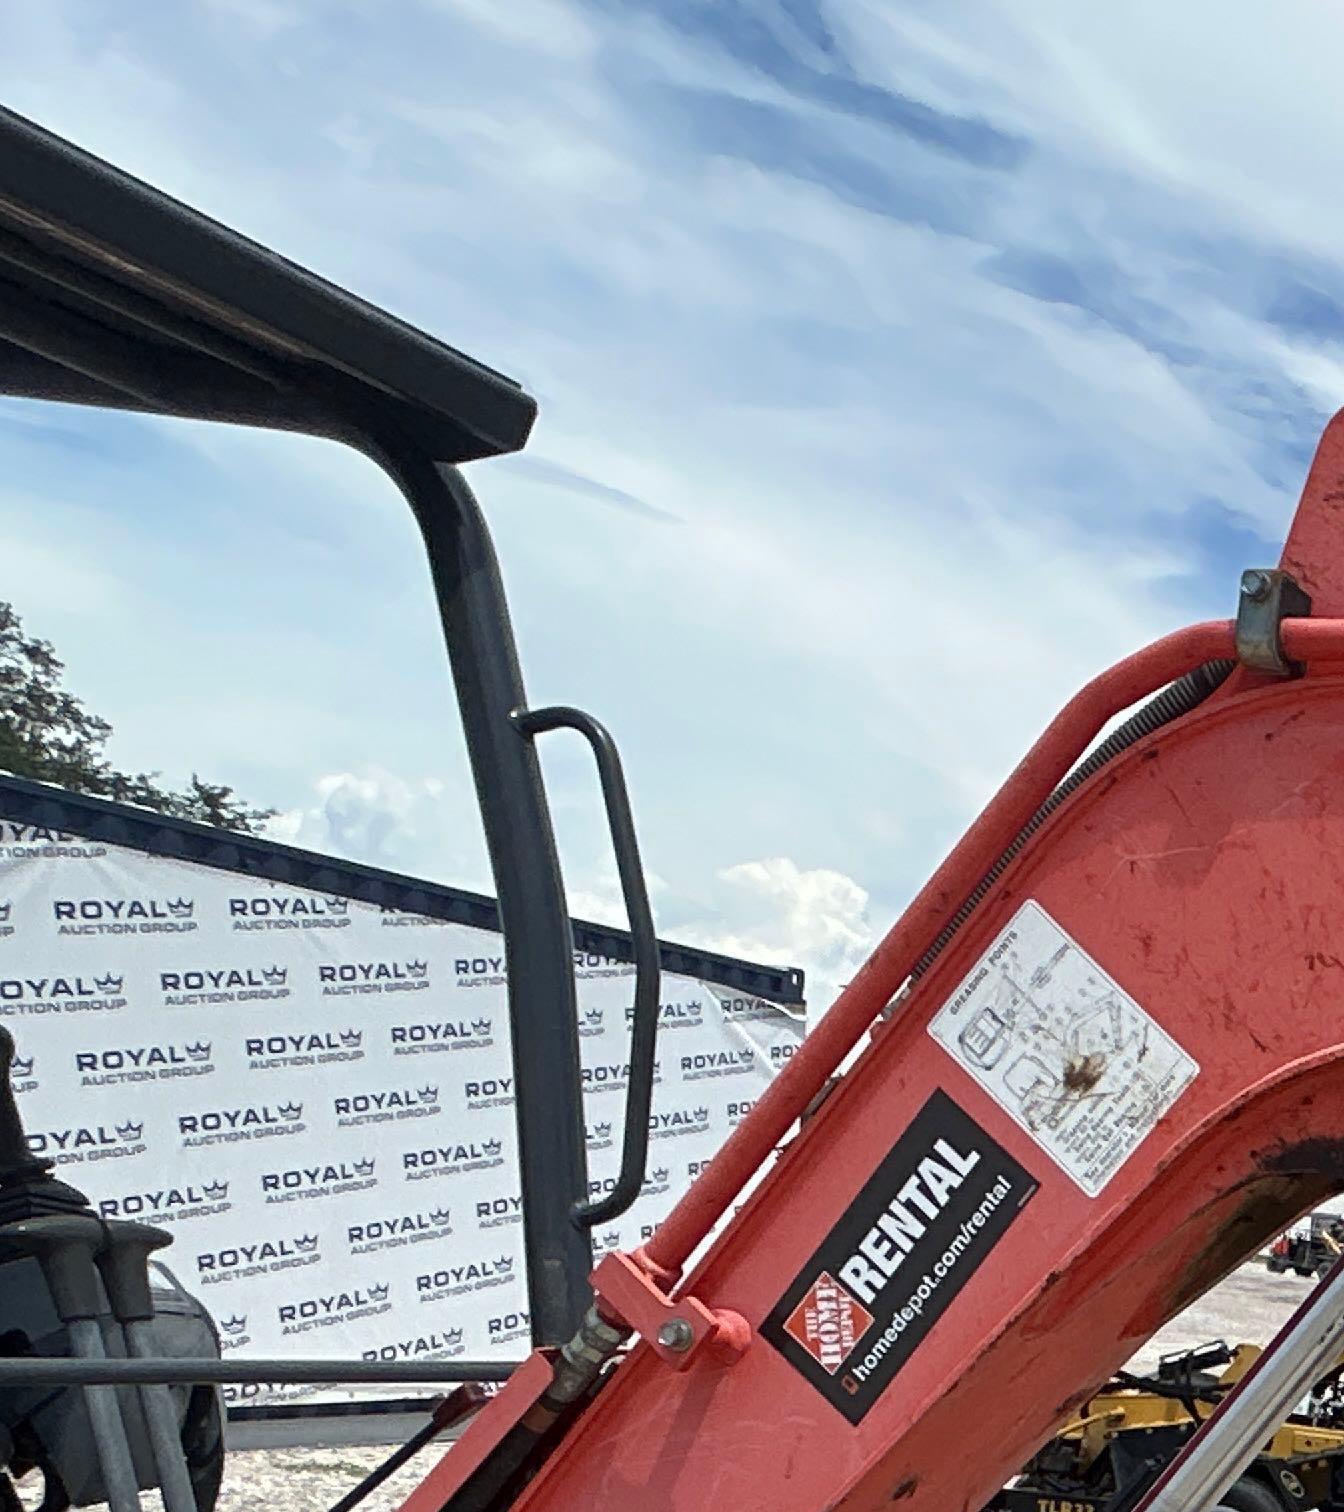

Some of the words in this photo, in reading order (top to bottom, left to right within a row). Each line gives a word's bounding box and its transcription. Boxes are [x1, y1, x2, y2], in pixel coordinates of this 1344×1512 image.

[54, 898, 168, 920] ROYAL
[230, 898, 325, 917] ROYAL
[320, 963, 407, 982] ROYAL
[454, 958, 508, 975] ROY
[0, 977, 95, 999] OYAL
[161, 971, 263, 992] ROYAL
[0, 1002, 61, 1015] CTION
[391, 1022, 472, 1043] ROYAL
[246, 1033, 340, 1056] ROYAL
[76, 1047, 186, 1071] ROYAL
[681, 1052, 739, 1070] ROYAL
[581, 1064, 630, 1082] ROYA
[465, 1079, 512, 1098] ROY
[335, 1089, 418, 1114] ROYAL
[178, 1106, 280, 1134] ROYAL
[648, 1111, 694, 1130] OYAL
[25, 1126, 116, 1152] OYAL
[403, 1143, 483, 1169] ROYAL
[262, 1163, 354, 1192] ROYAL
[99, 1187, 203, 1218] ROYAL
[476, 1196, 523, 1218] ROY
[348, 1214, 430, 1244] ROYAL
[838, 1137, 981, 1304] RENTAL
[197, 1240, 296, 1273] ROYAL
[417, 1261, 494, 1292] ROYAL
[852, 1174, 1013, 1383] homedepot.com/rental
[279, 1289, 369, 1323] ROYAL
[488, 1312, 530, 1334] ROY
